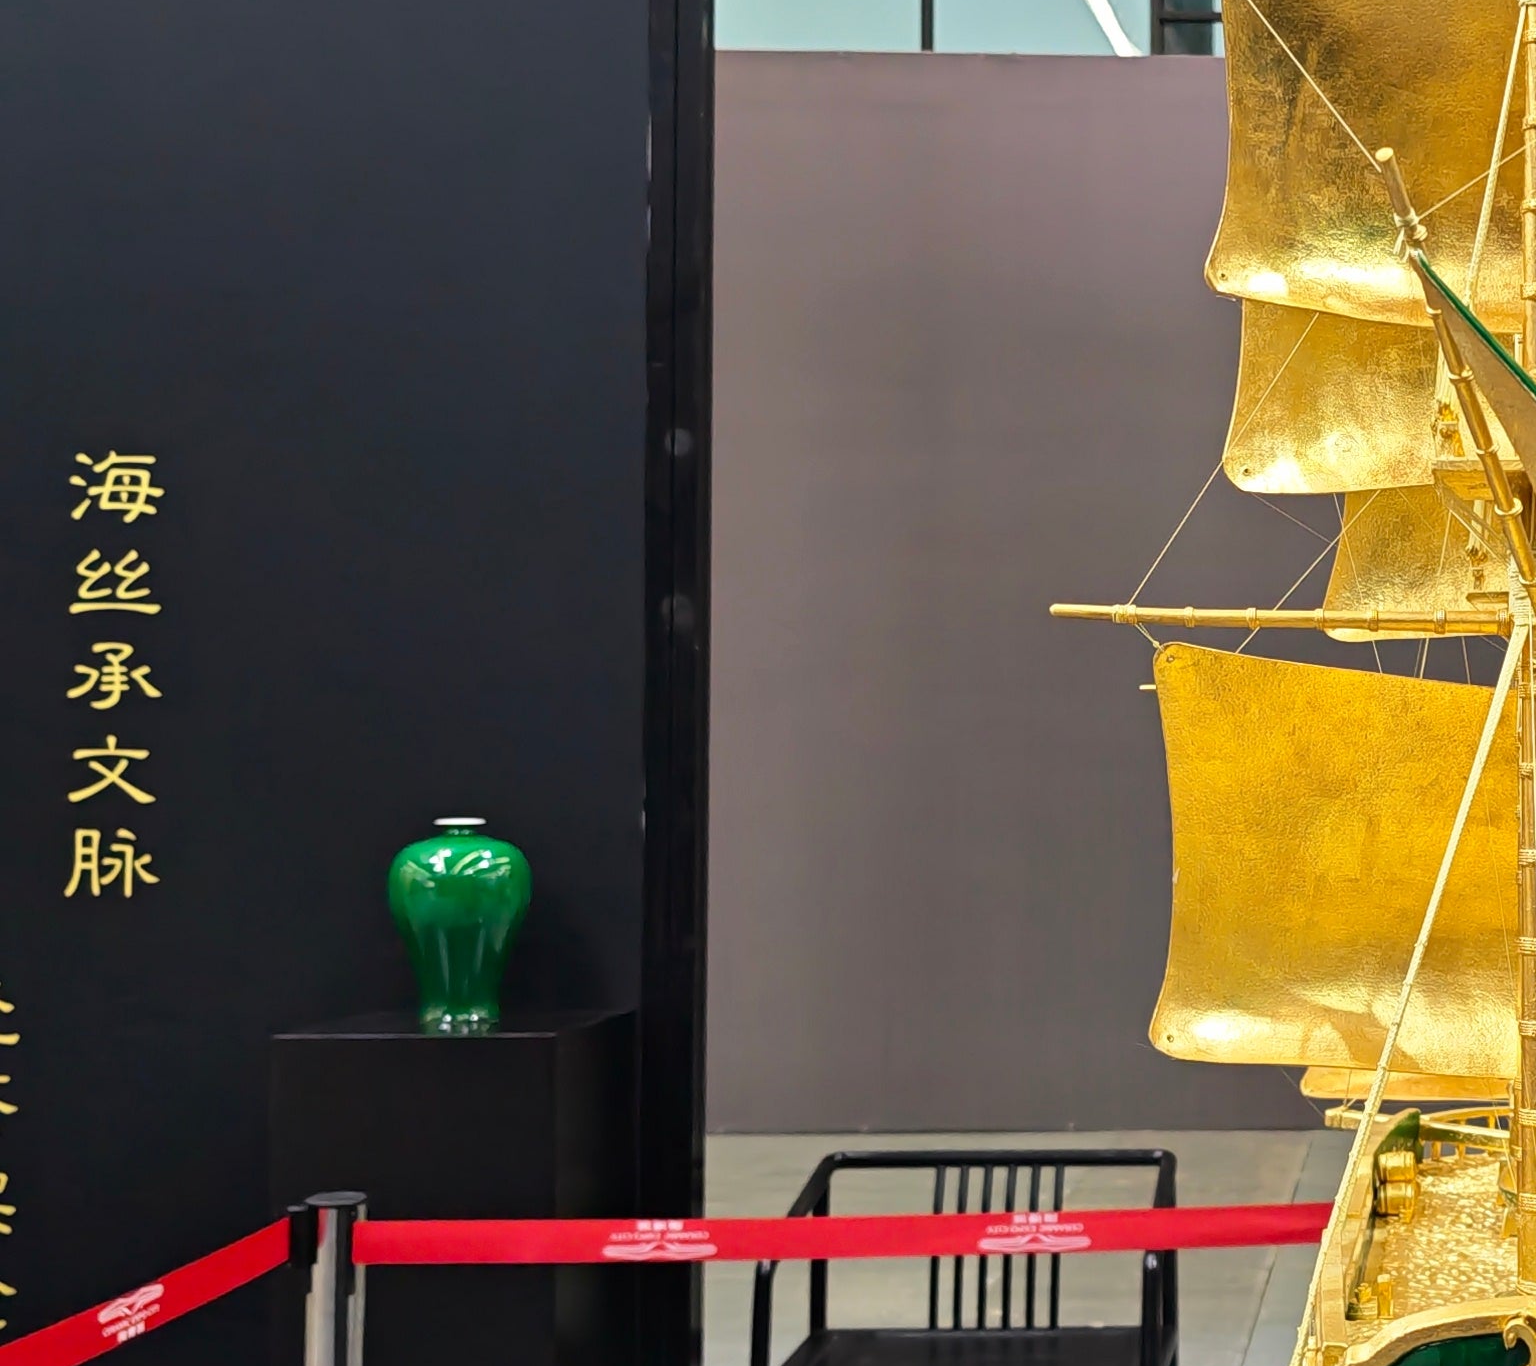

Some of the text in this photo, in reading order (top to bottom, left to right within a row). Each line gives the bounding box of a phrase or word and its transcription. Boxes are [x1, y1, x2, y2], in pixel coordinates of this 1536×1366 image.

[63, 450, 166, 898] 海丝承文脉
